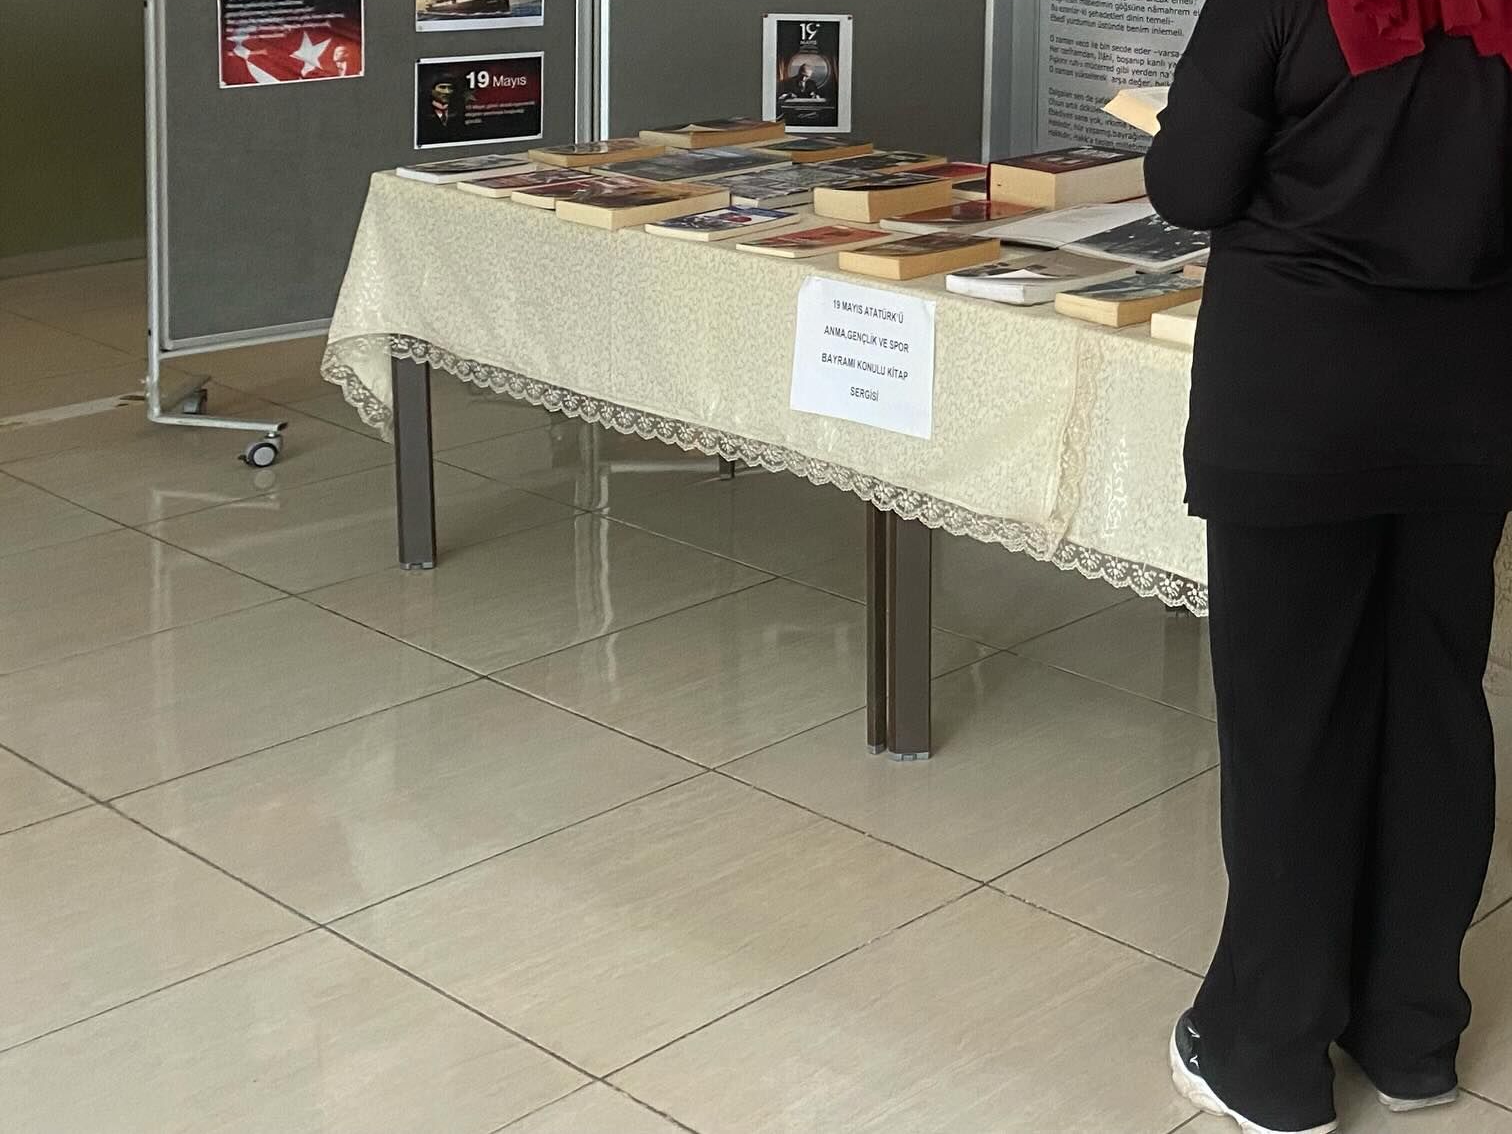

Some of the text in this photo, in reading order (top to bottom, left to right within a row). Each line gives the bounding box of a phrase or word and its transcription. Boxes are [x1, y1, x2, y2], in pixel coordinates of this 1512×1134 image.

[466, 71, 527, 88] 19 Mayıs
[833, 299, 840, 310] 19
[842, 301, 863, 315] MAYIS
[879, 338, 888, 348] VE
[889, 339, 909, 353] SPOR
[821, 353, 908, 381] BAYRAMI KONULU KİTAP
[850, 386, 879, 401] SERGİSİ
